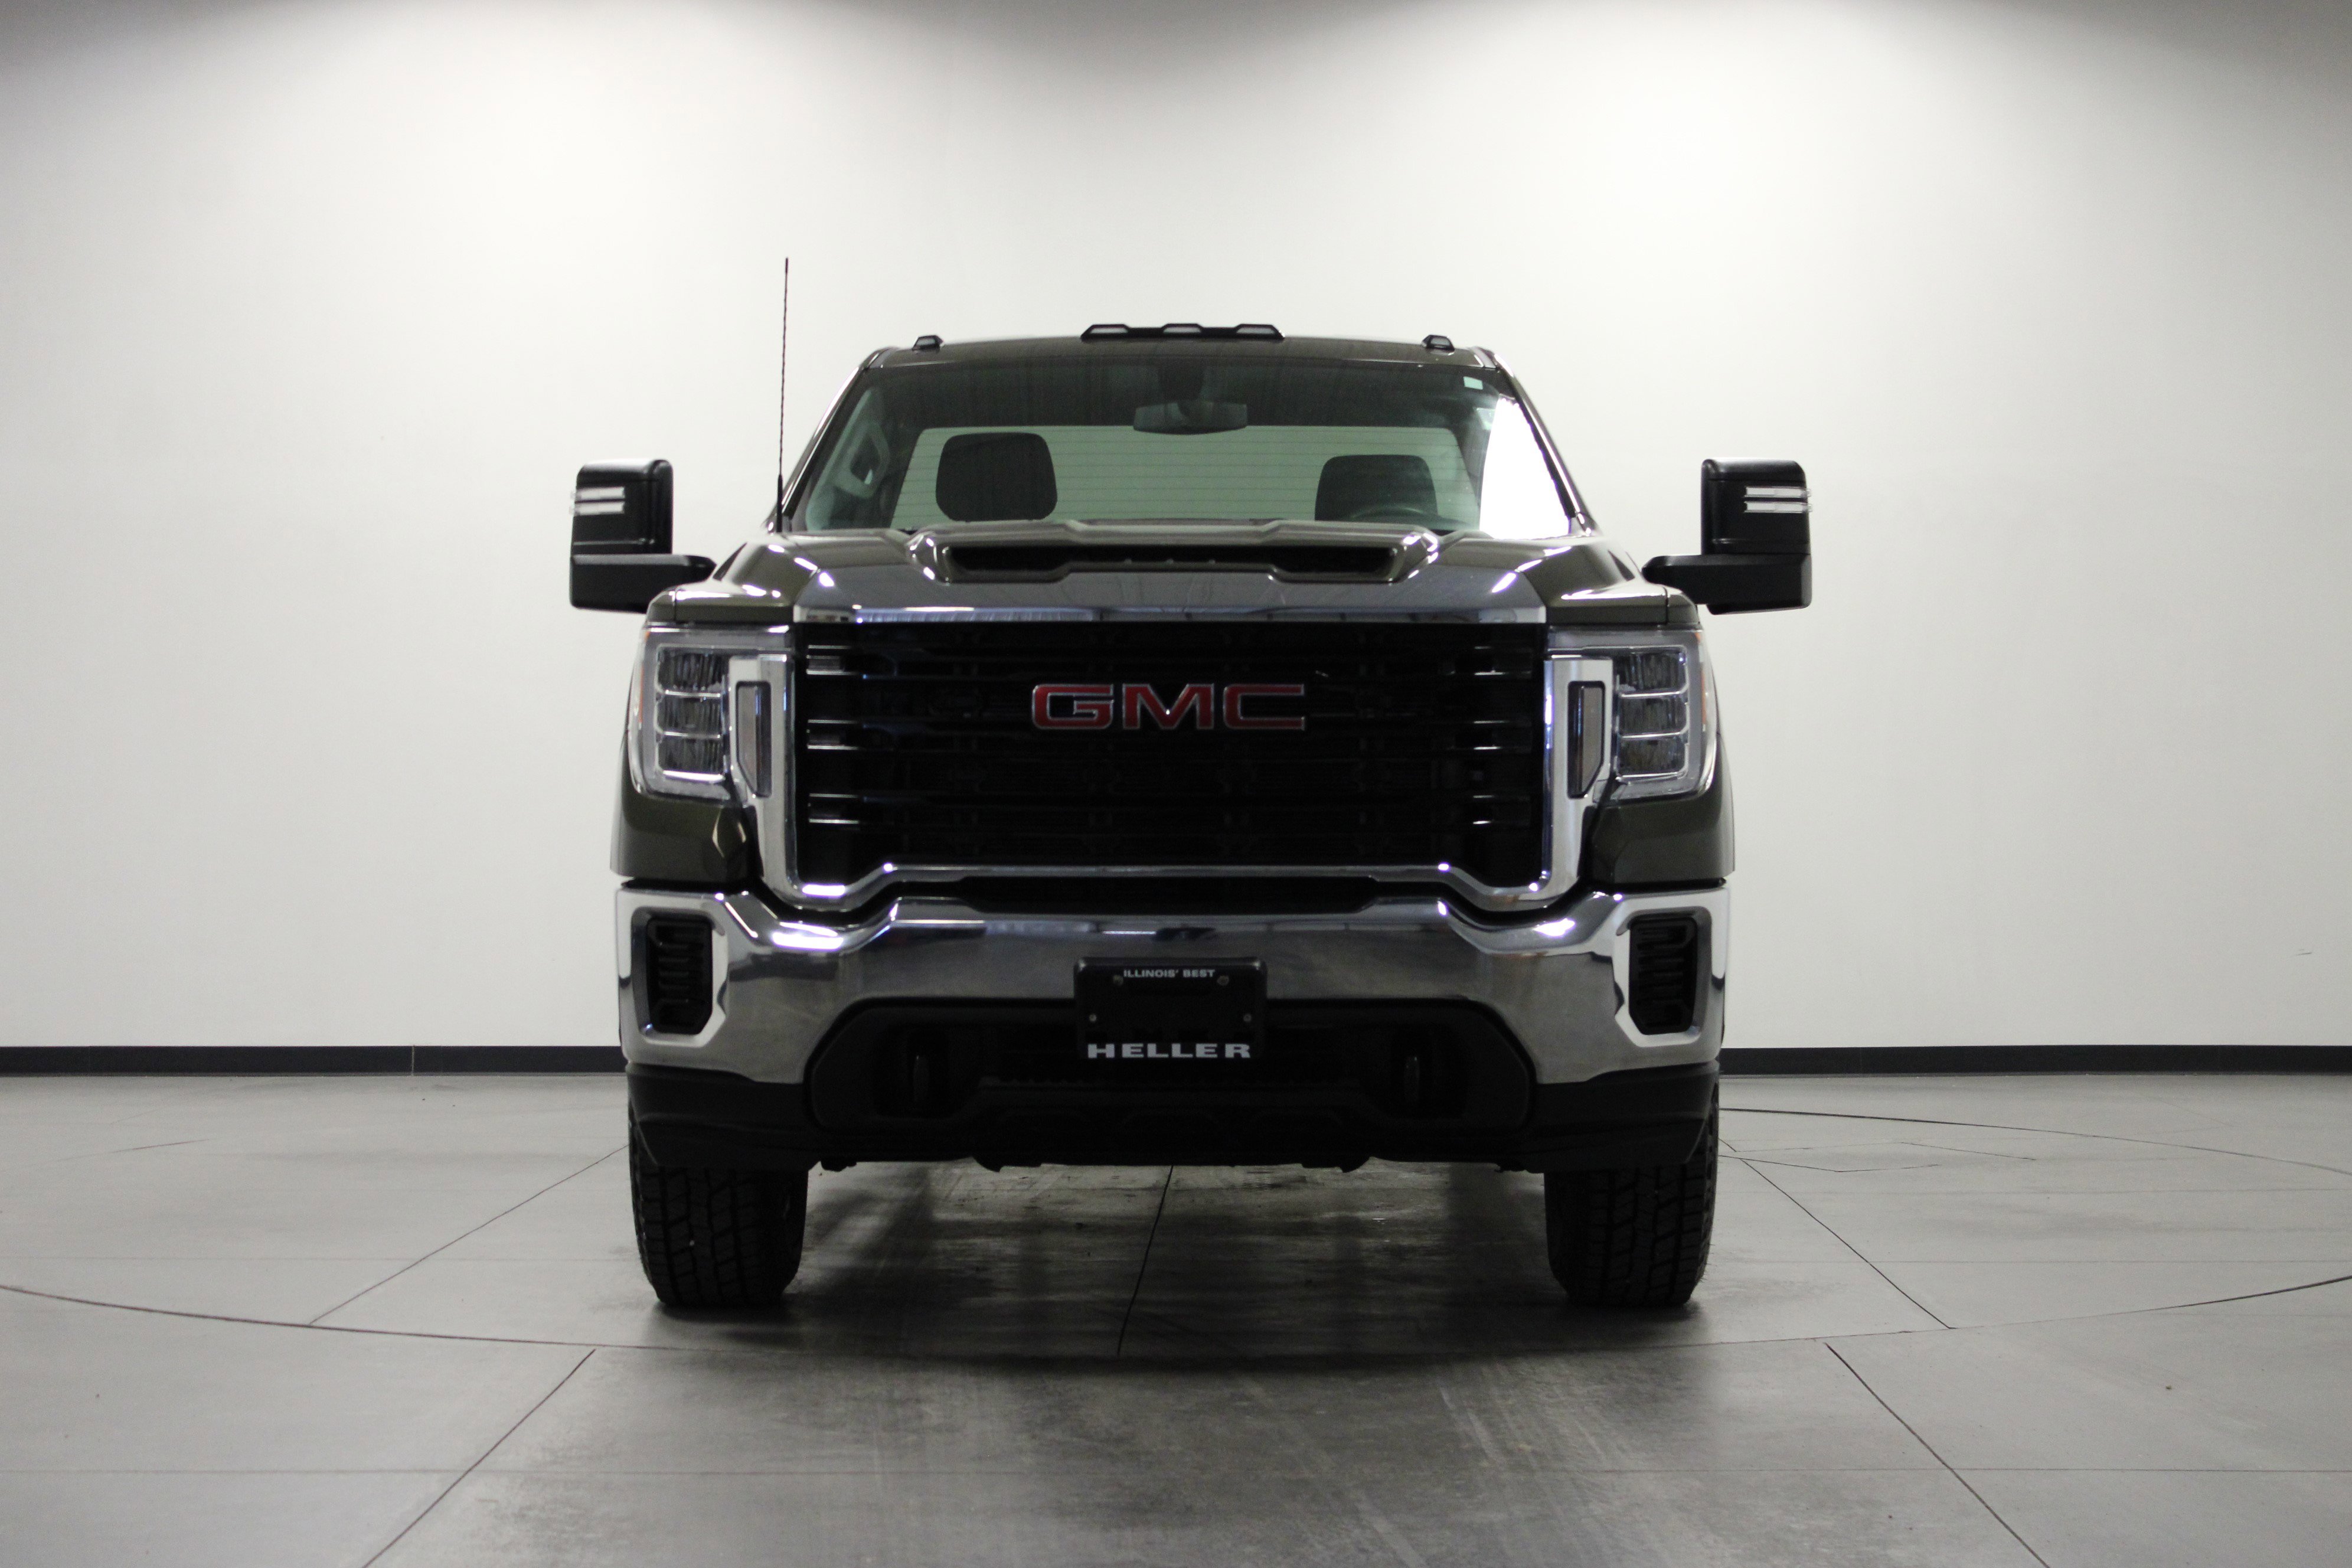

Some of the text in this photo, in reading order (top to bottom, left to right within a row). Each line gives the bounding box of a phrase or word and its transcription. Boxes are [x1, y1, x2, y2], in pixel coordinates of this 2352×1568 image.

[1031, 683, 1305, 730] GMC
[1123, 969, 1216, 978] ILLINOIS' BEST
[1087, 1043, 1250, 1058] HELLER
